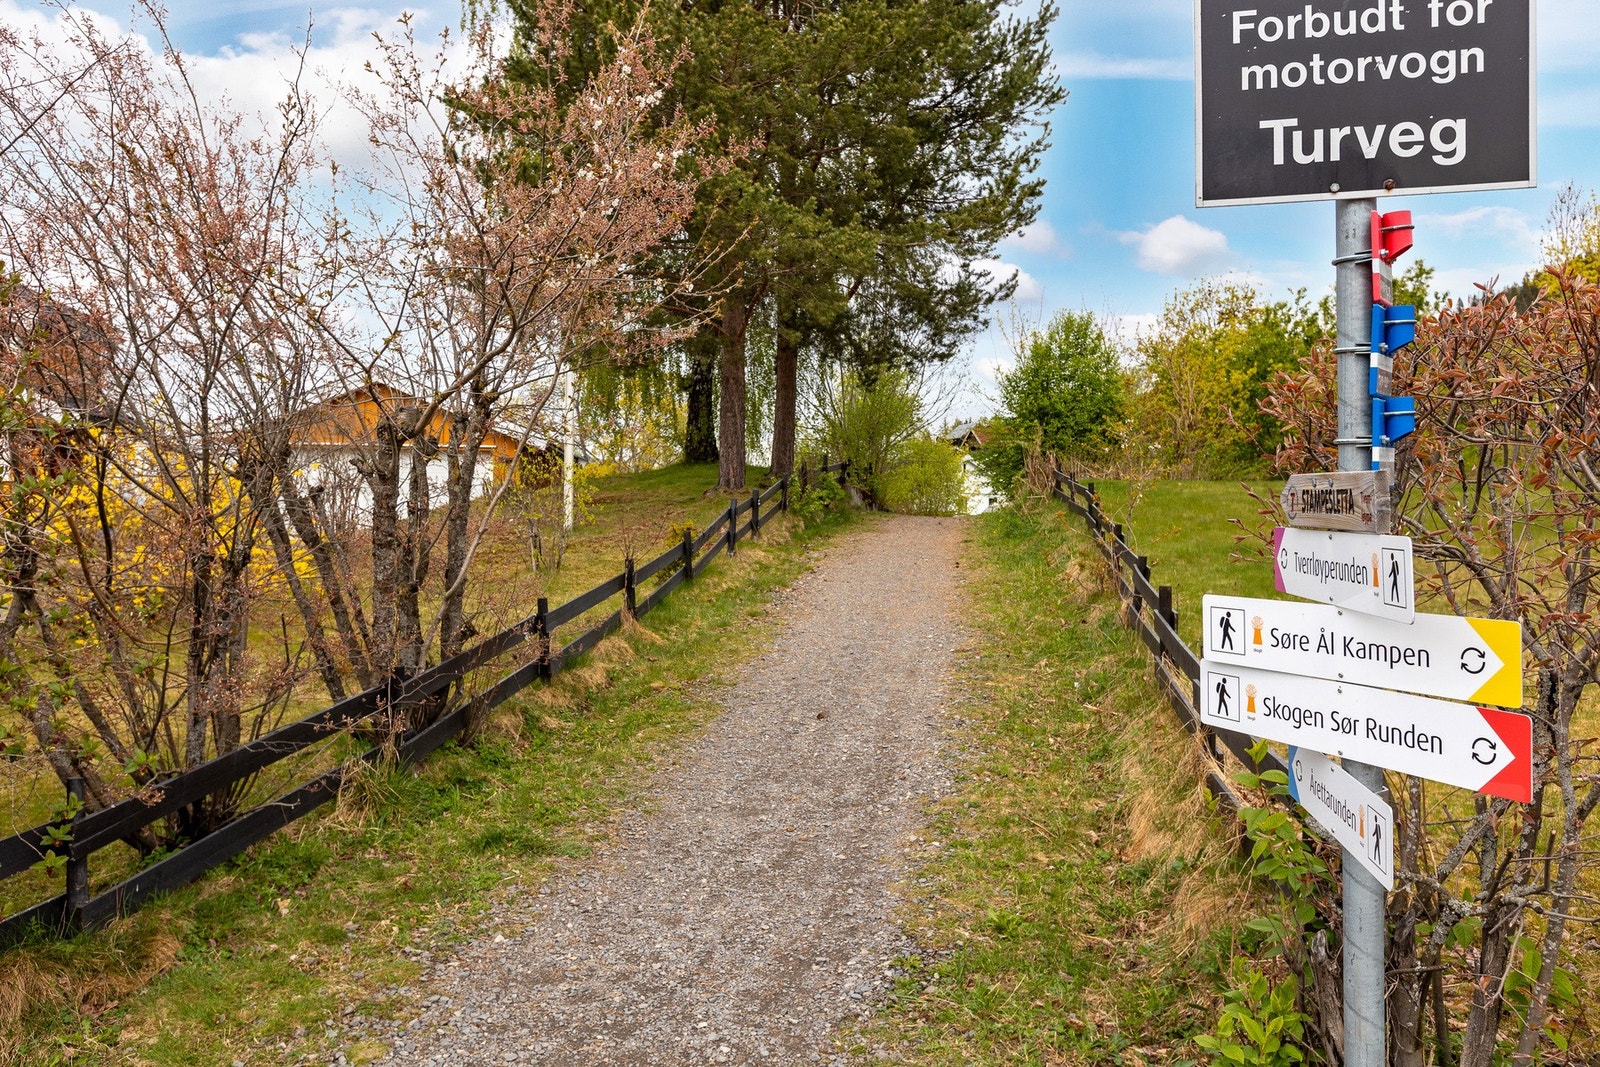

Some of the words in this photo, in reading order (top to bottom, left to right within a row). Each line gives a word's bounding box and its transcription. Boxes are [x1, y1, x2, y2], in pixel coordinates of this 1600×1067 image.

[1232, 0, 1405, 45] Forbudt
[1428, 0, 1493, 28] for
[1241, 47, 1485, 91] motorvogn
[1259, 117, 1467, 166] Turveg
[1301, 488, 1355, 515] STAMPESLETTA
[1294, 551, 1368, 585] Tverrløyperunden
[1270, 627, 1310, 651] Søre
[1316, 627, 1334, 655] Ål
[1343, 636, 1430, 670] Kampen
[1263, 696, 1324, 729] Skogen
[1330, 711, 1360, 736] Sør
[1366, 718, 1443, 755] Runden
[1309, 768, 1357, 832] Årettarunden
